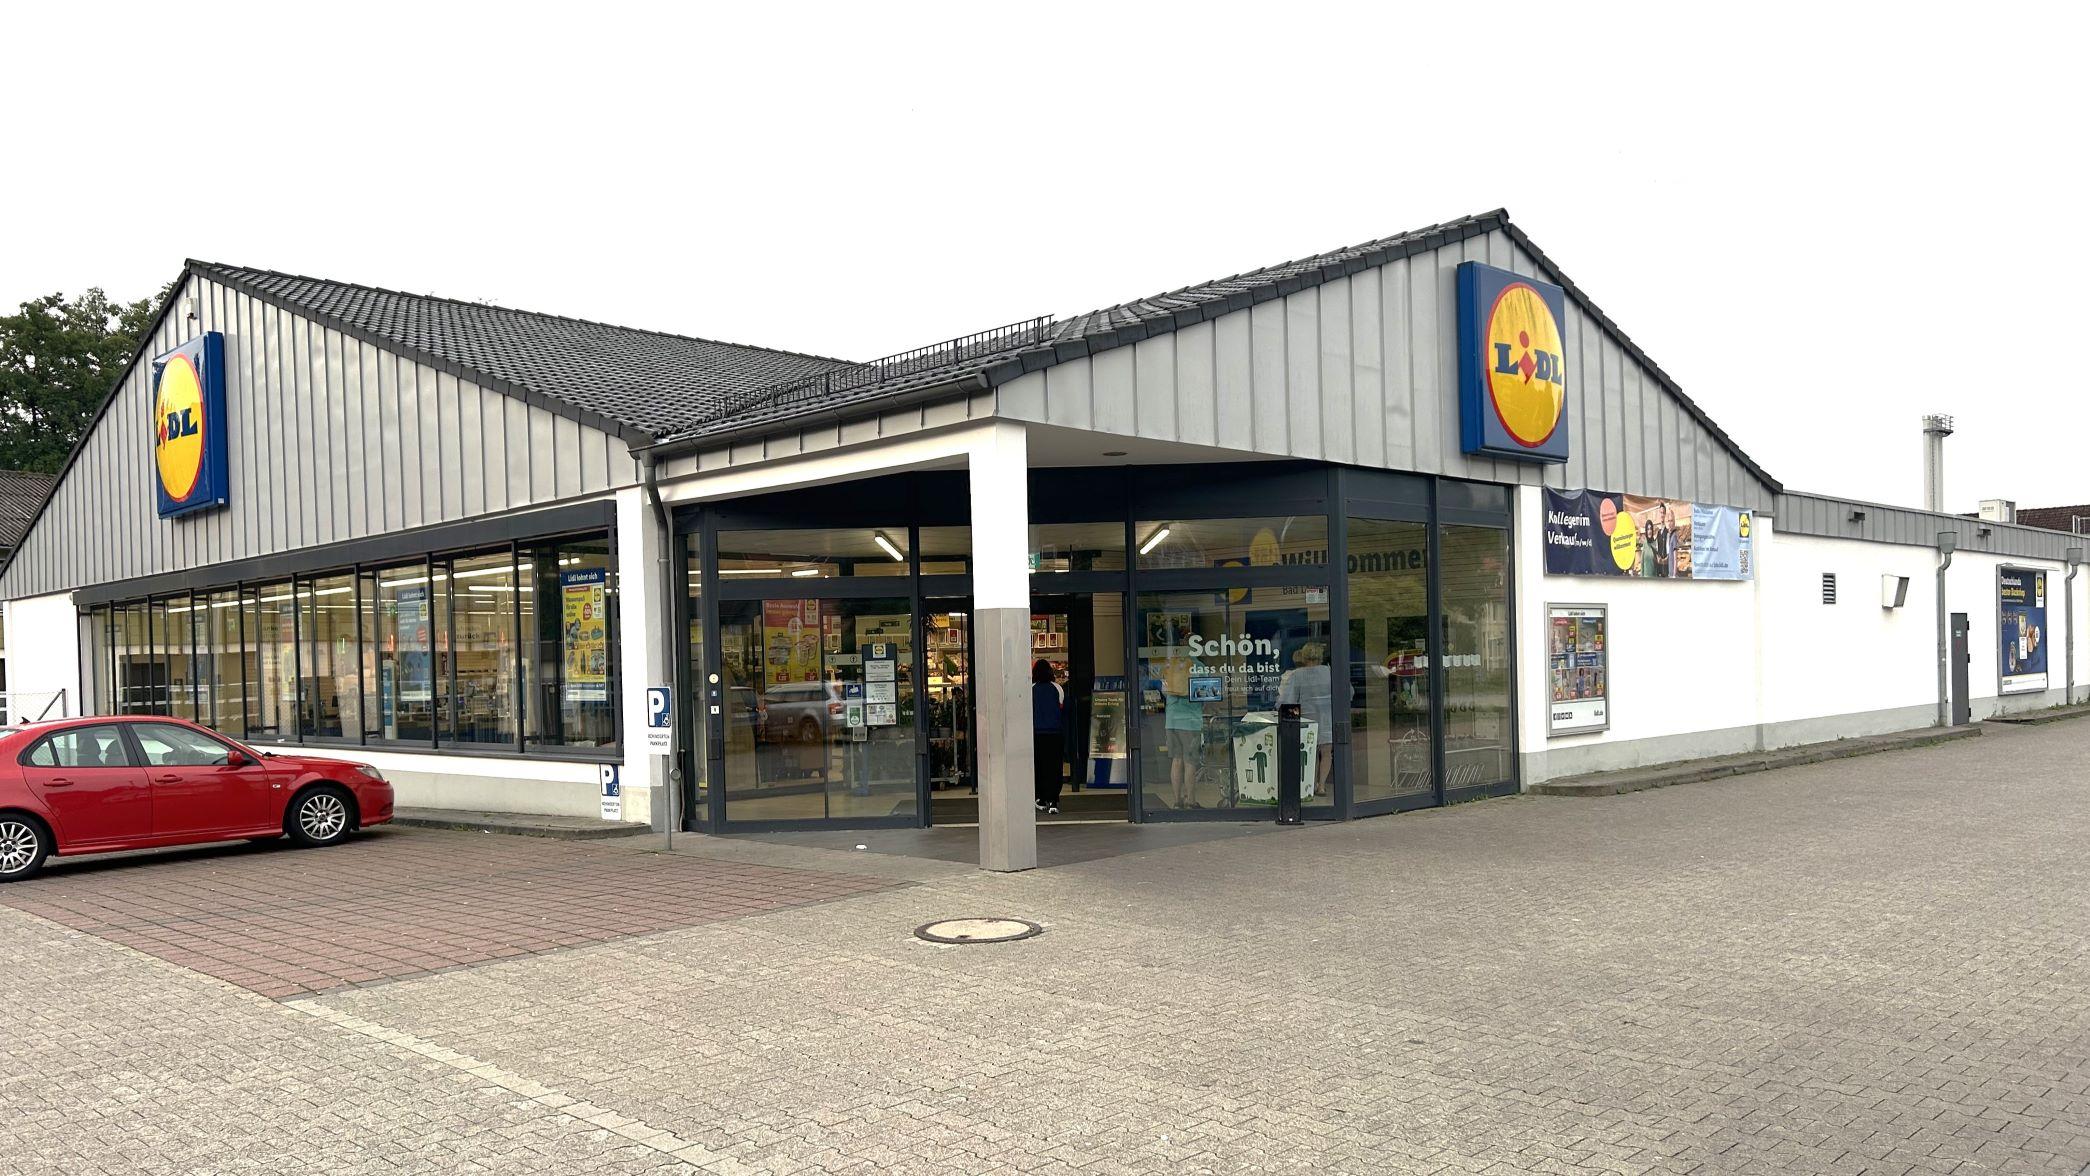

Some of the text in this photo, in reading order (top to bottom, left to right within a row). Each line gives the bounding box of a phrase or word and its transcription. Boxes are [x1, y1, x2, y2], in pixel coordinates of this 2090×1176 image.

[1188, 633, 1280, 659] Schön,
[1190, 661, 1280, 674] dass du da bist
[1224, 675, 1242, 683] Dein
[1245, 674, 1280, 683] Lidl-Team
[648, 690, 665, 726] P
[600, 764, 614, 795] P
